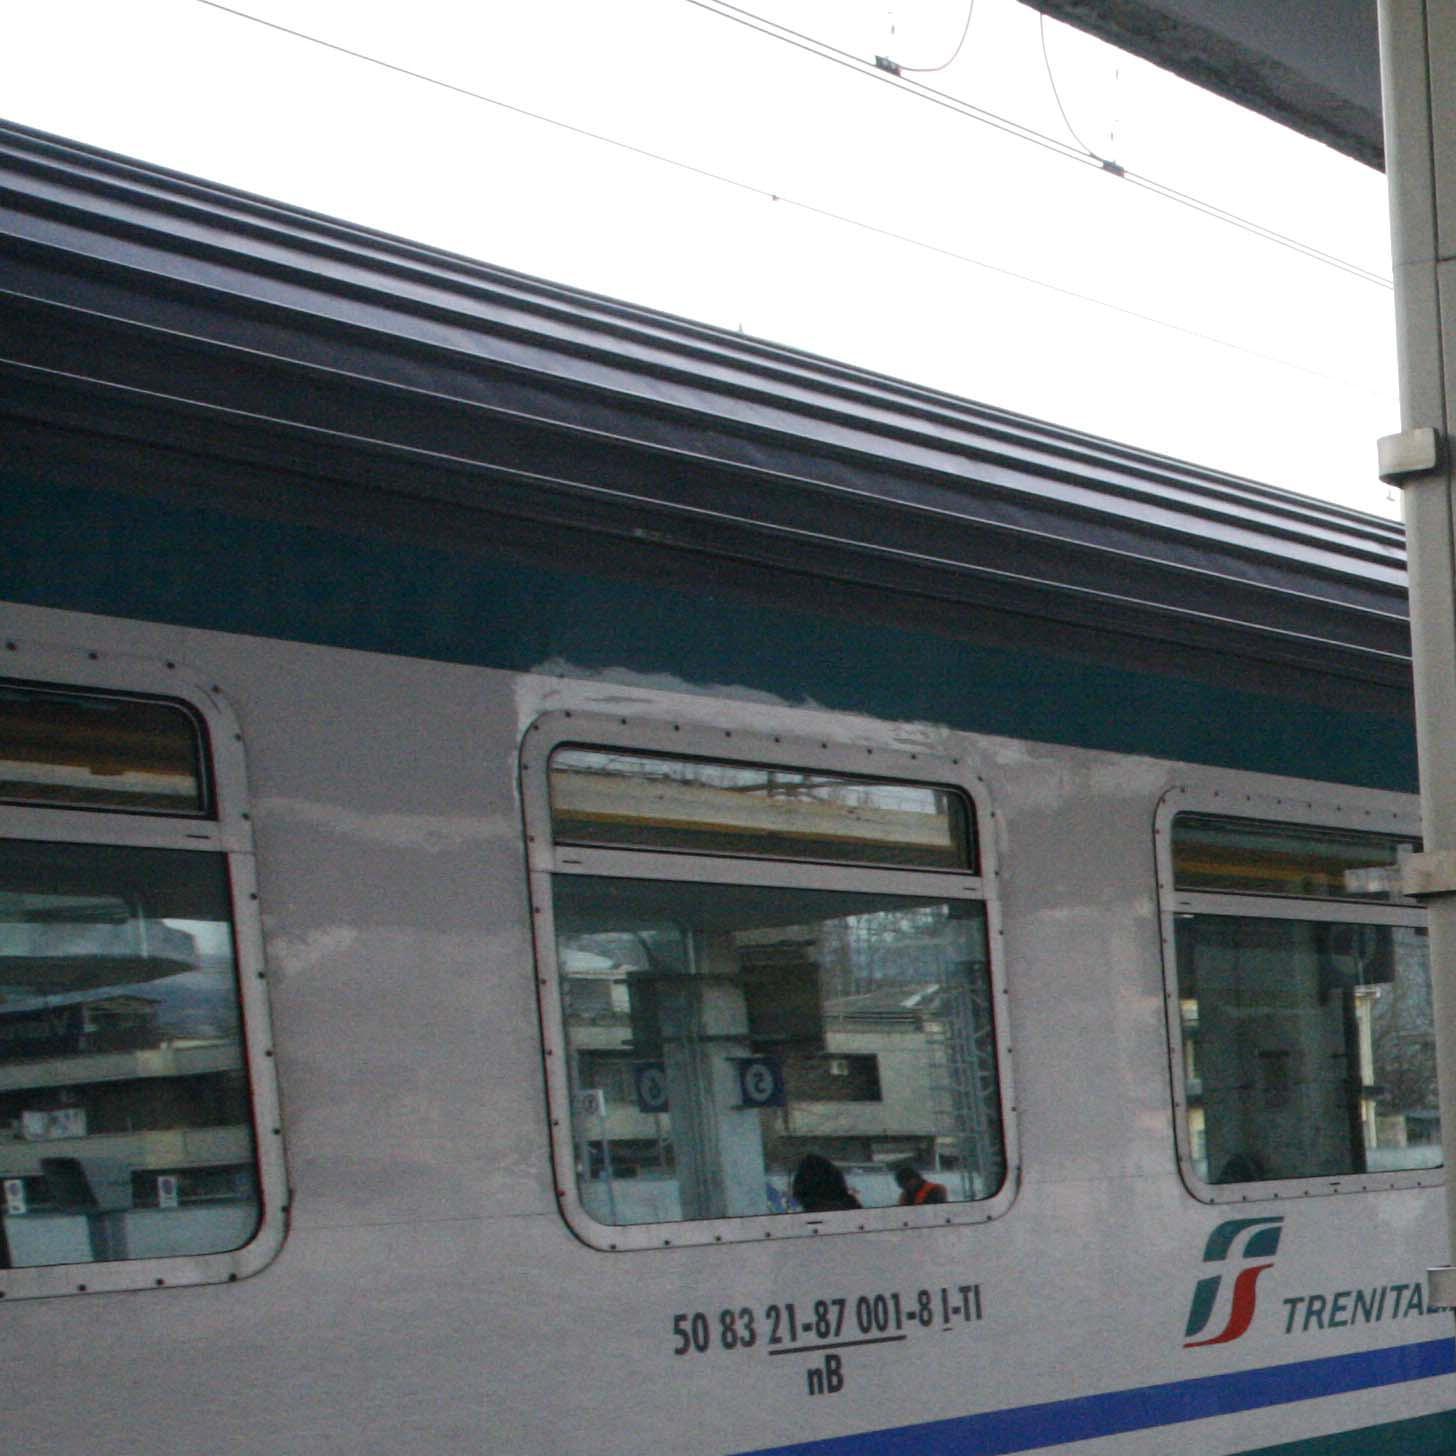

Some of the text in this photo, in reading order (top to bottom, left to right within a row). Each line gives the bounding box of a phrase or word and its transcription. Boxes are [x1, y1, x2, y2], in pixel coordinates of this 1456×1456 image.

[672, 1311, 711, 1356] 50
[719, 1306, 757, 1351] 83
[765, 1298, 847, 1345] 21-87
[856, 1288, 934, 1335] 001-8
[1283, 1282, 1455, 1335] TRENITA
[807, 1354, 845, 1396] nB
